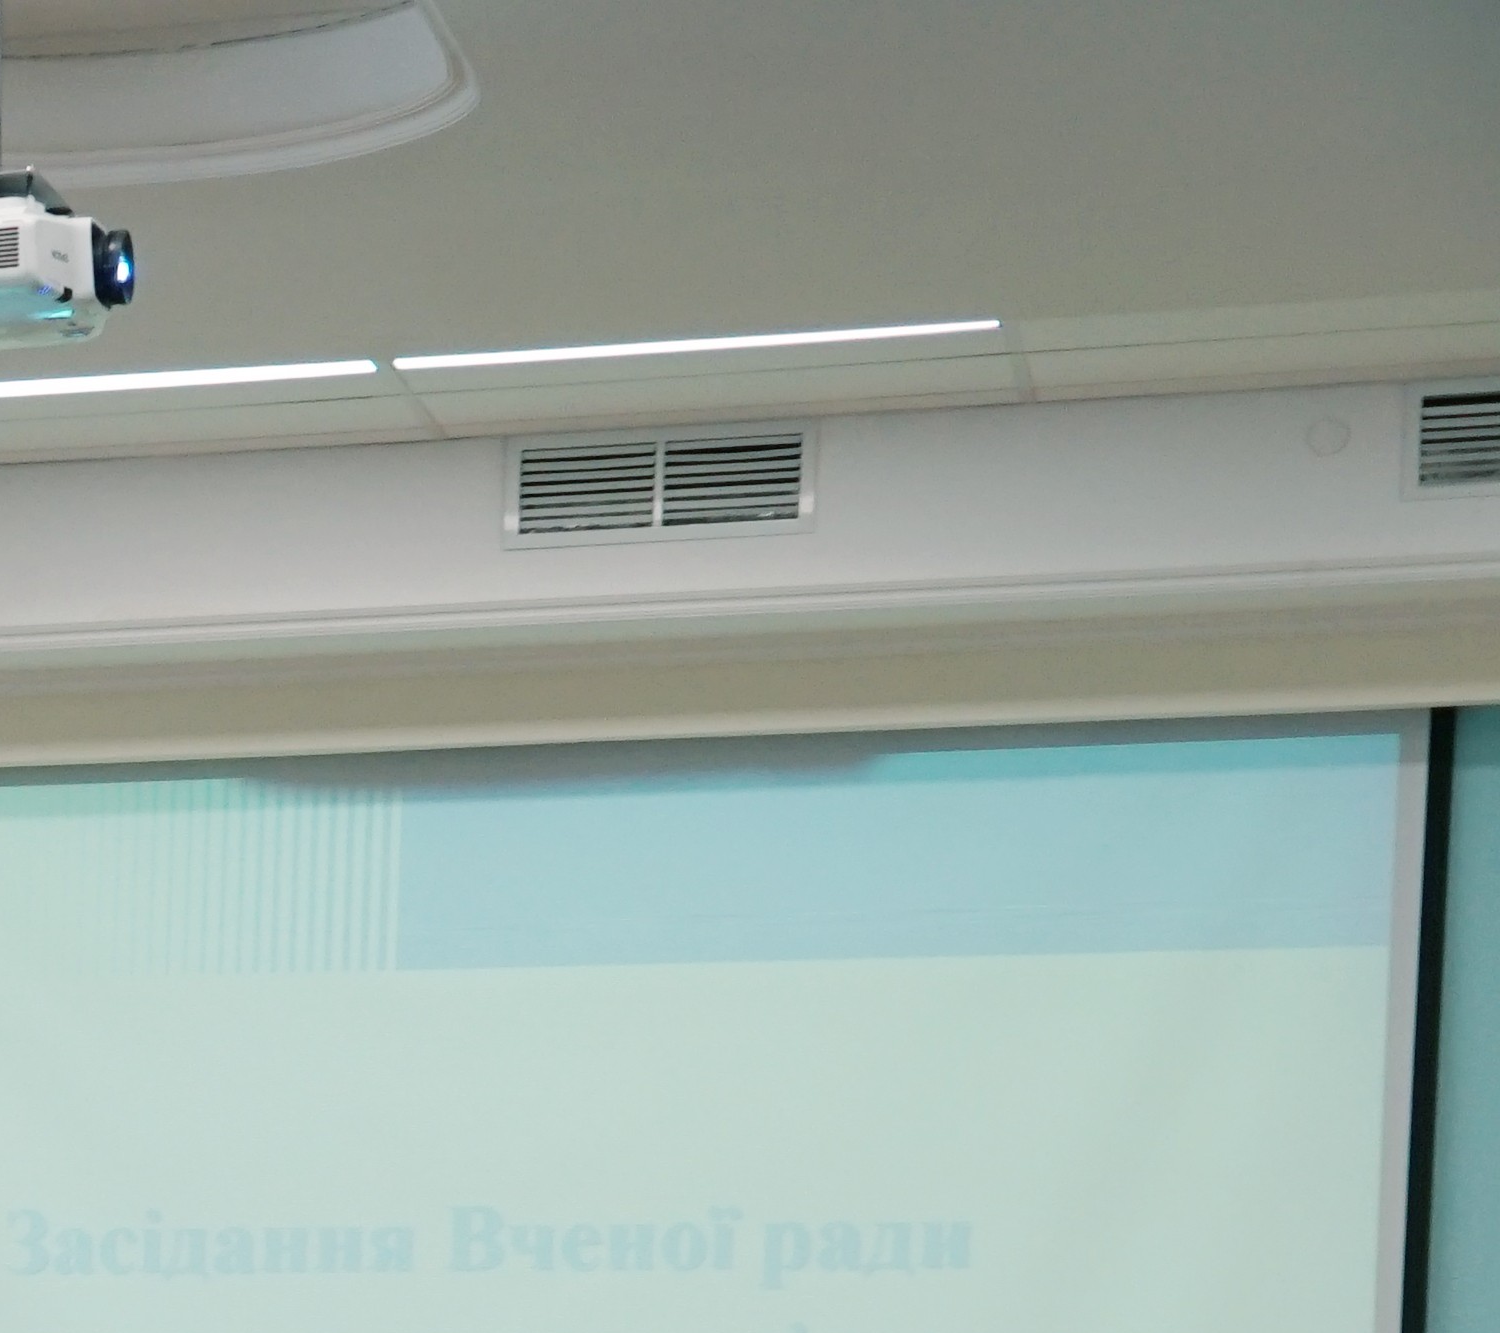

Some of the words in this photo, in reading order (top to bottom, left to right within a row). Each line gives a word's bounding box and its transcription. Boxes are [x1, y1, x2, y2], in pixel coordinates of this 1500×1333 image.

[6, 1207, 416, 1279] Засідання
[449, 1203, 745, 1274] Вченої
[761, 1217, 974, 1290] ради
